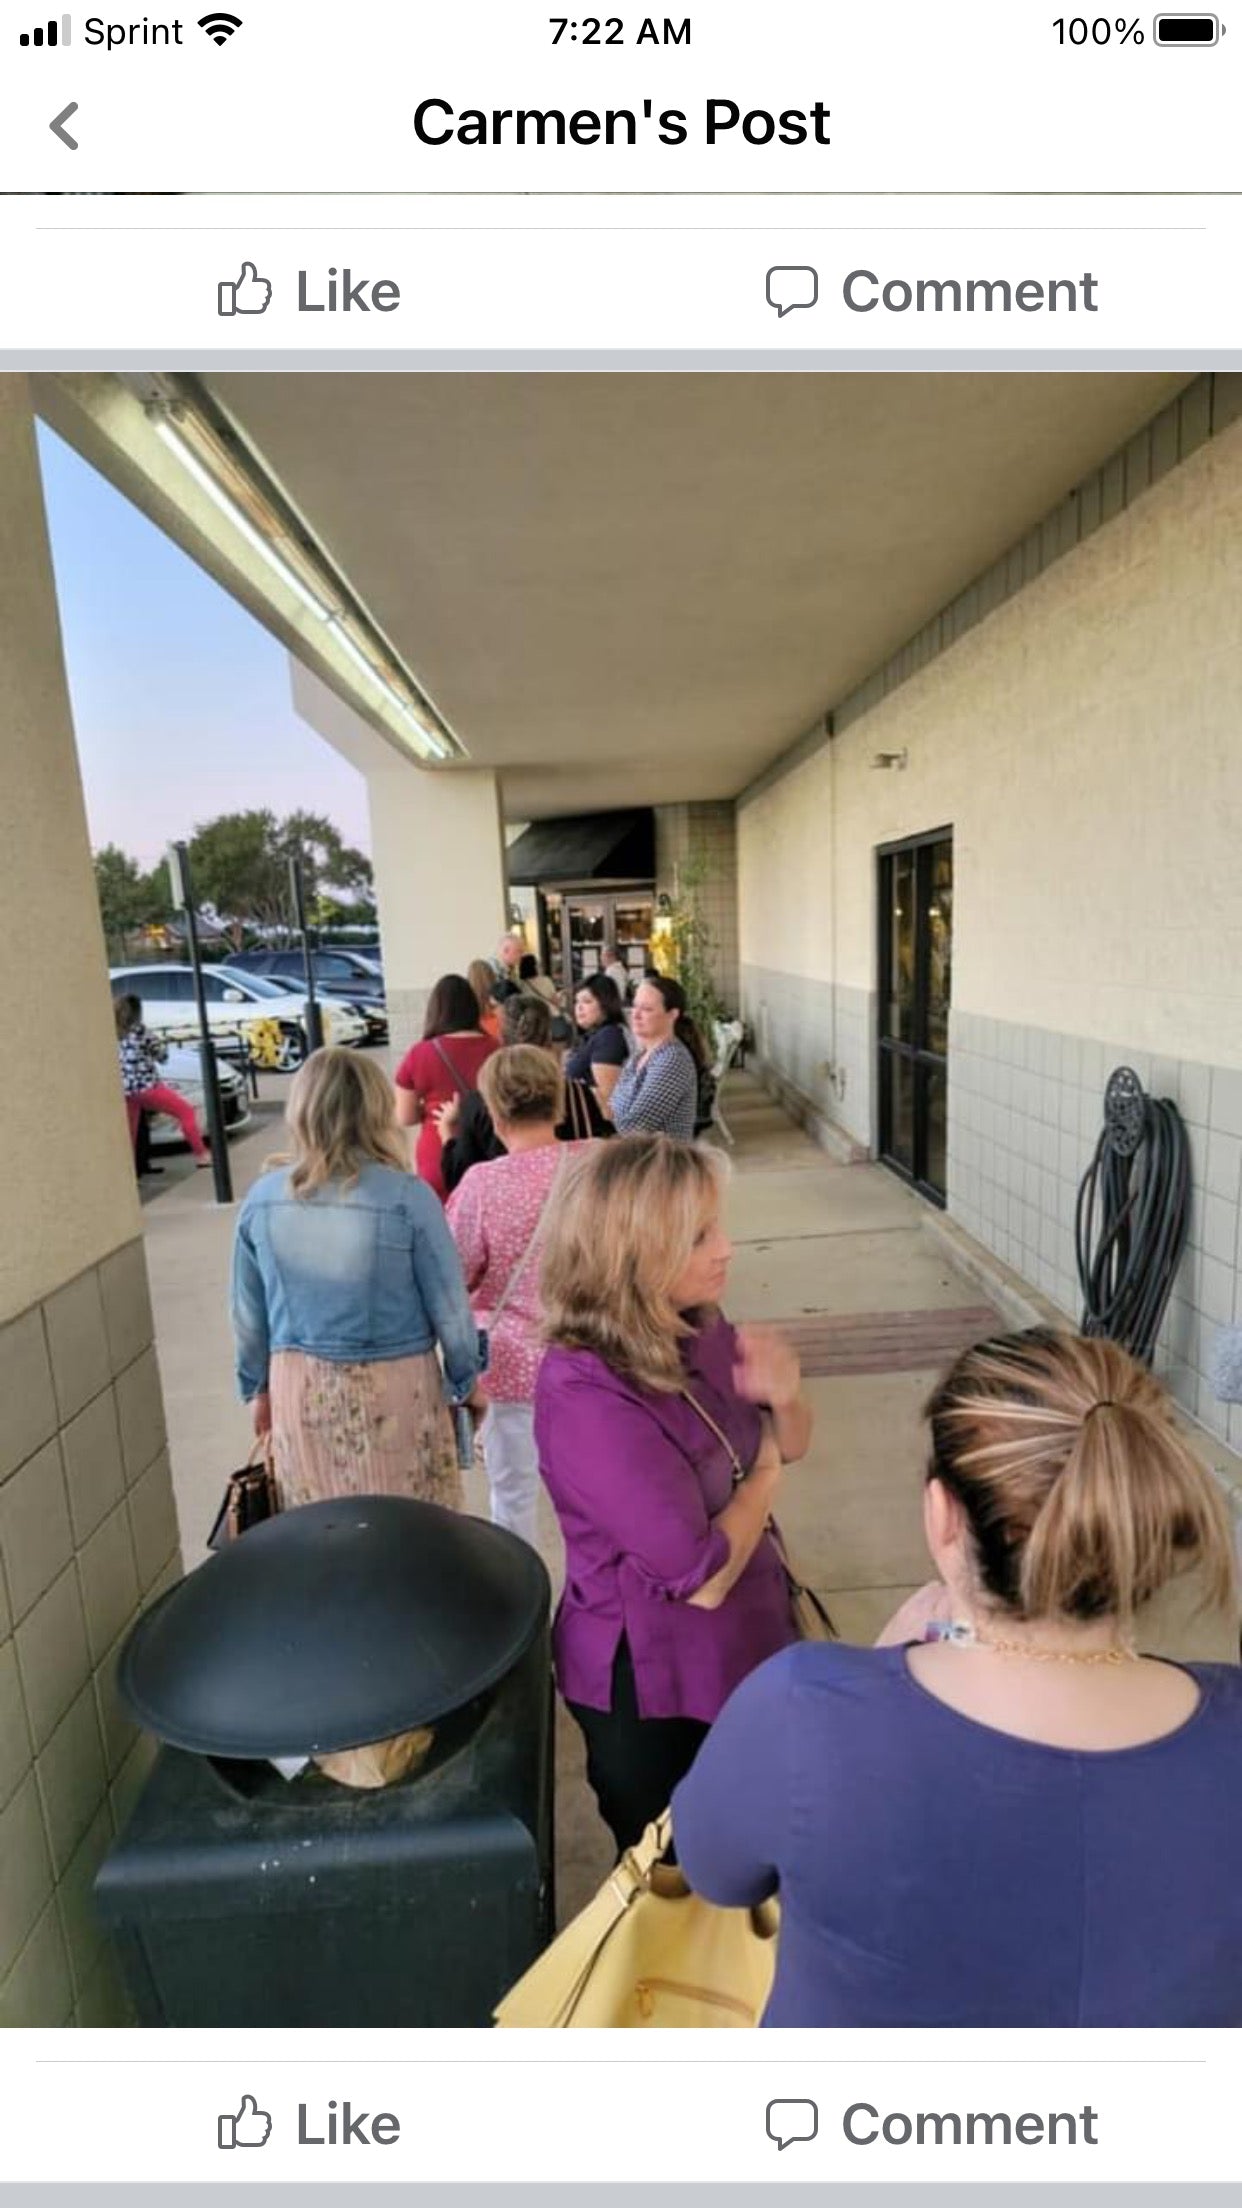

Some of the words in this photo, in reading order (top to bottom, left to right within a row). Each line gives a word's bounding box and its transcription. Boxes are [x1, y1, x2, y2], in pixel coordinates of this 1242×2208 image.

[84, 16, 184, 52] Sprint
[549, 17, 624, 45] 7:22
[635, 17, 691, 45] AM
[1052, 17, 1145, 46] 100%
[413, 98, 688, 146] Carmen's
[706, 98, 831, 146] Post
[298, 267, 401, 313] Like
[842, 269, 1099, 313] Comment
[298, 2100, 401, 2145] Like
[842, 2102, 1099, 2146] Comment
